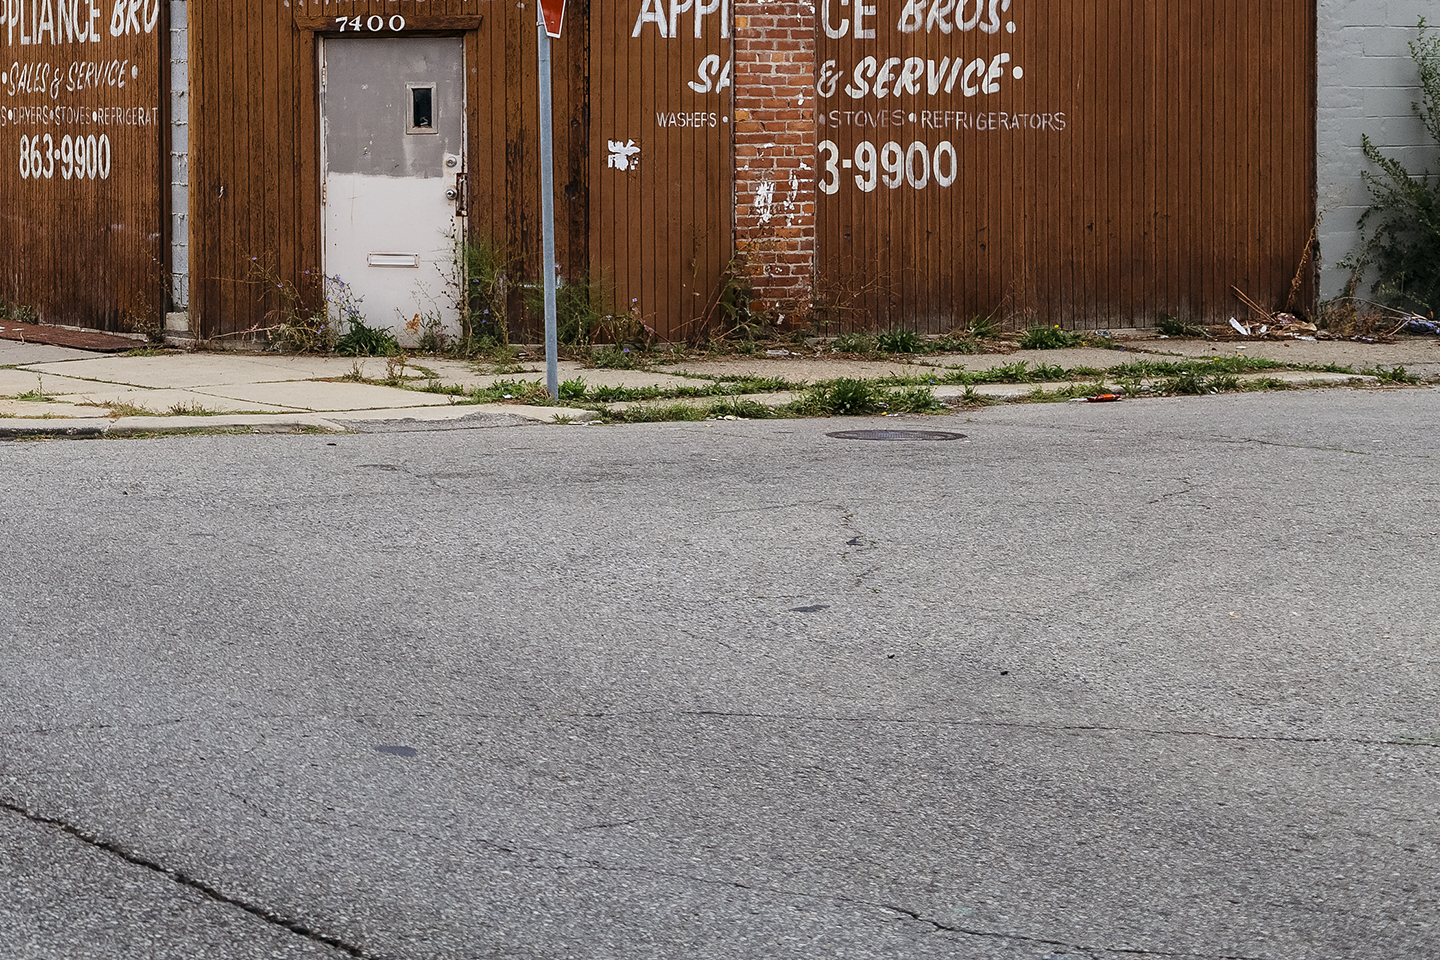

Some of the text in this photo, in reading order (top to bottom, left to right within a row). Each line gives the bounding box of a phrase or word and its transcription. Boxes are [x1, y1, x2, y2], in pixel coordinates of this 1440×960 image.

[335, 15, 405, 32] 7400
[7, 59, 129, 100] SALES & SERVICE
[817, 52, 1011, 99] & SERVICE
[656, 110, 1067, 131] WASHERS STOVES REFRIGERATORS
